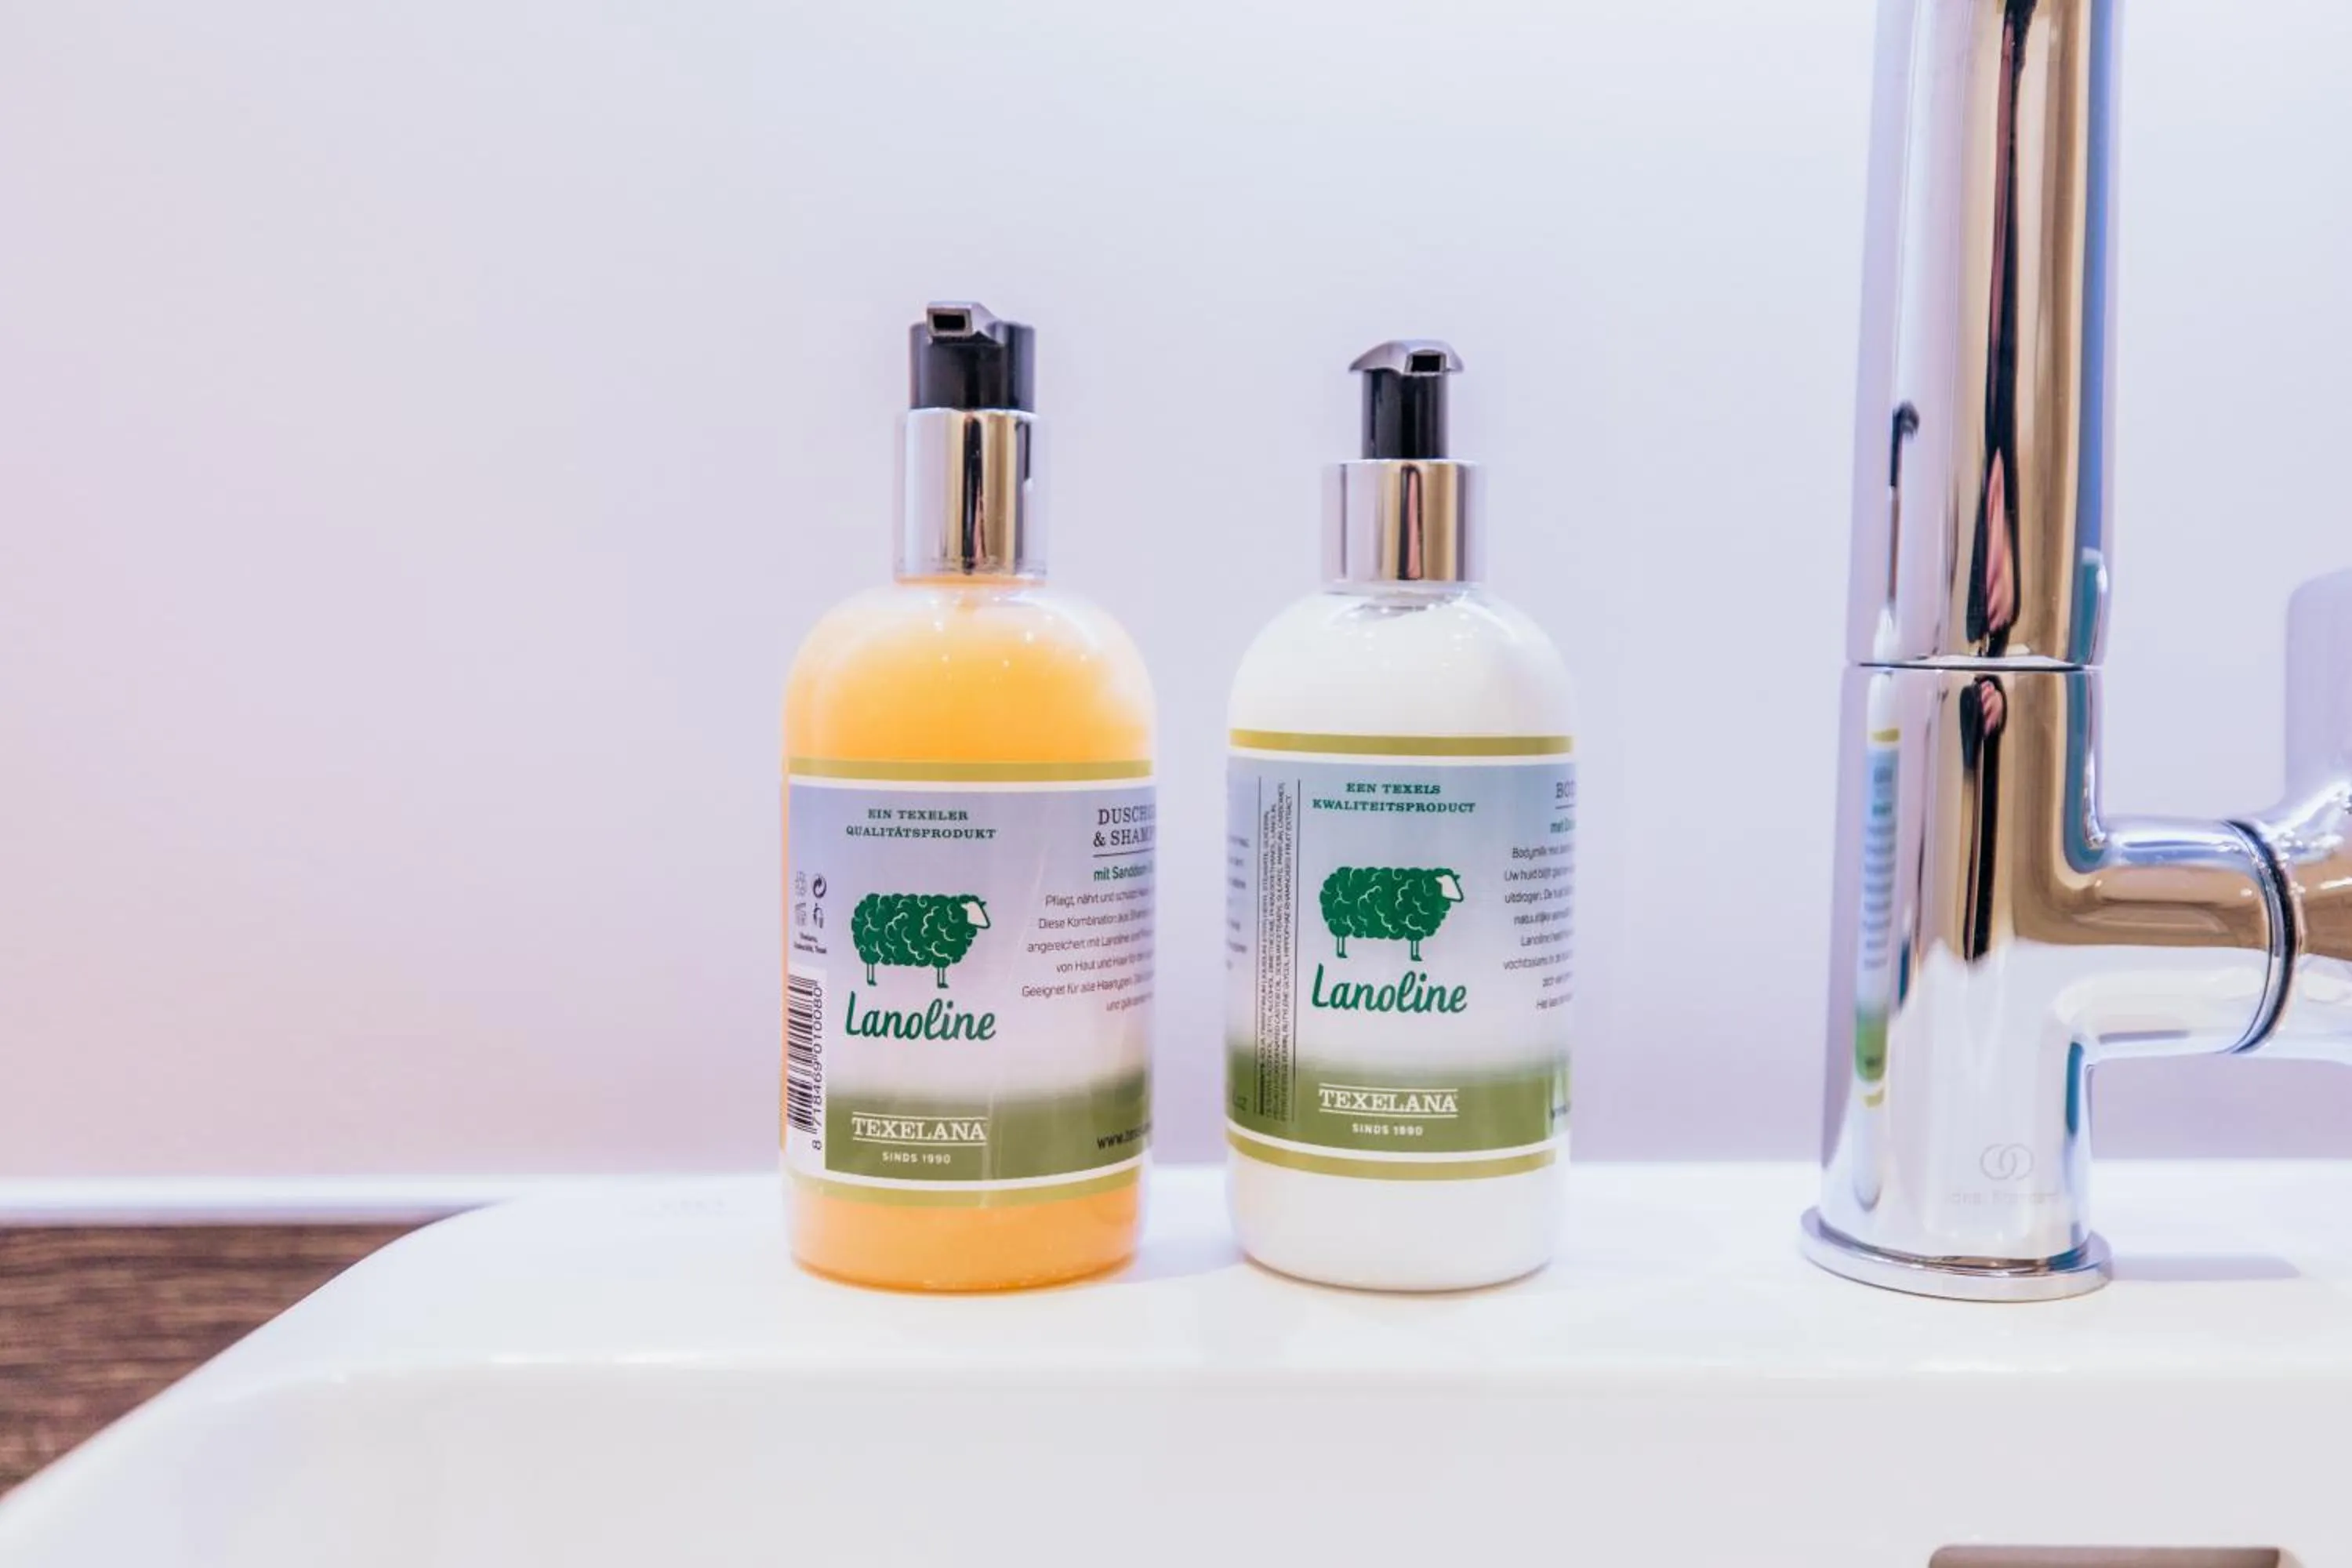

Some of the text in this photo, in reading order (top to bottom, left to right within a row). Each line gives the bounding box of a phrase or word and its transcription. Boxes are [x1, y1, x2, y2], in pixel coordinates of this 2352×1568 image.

[1346, 782, 1441, 794] EEN TEXELS
[1312, 798, 1476, 813] KWALITEITSPRODUCT
[868, 808, 969, 821] EIN TEXELER
[846, 825, 996, 839] QUALITÄTSPRODUKT
[1093, 829, 1106, 847] &
[1094, 867, 1110, 881] mit
[1038, 918, 1065, 929] Diese
[1056, 963, 1073, 973] von
[1075, 959, 1095, 971] Haut
[1022, 983, 1065, 998] Geeignet
[1312, 963, 1467, 1013] Lanoline
[846, 991, 996, 1040] Lanoline
[1319, 1088, 1458, 1112] TEXELANA
[851, 1116, 987, 1141] TEXELANA
[1352, 1123, 1388, 1135] SINDS
[882, 1151, 951, 1165] SINDS 1990
